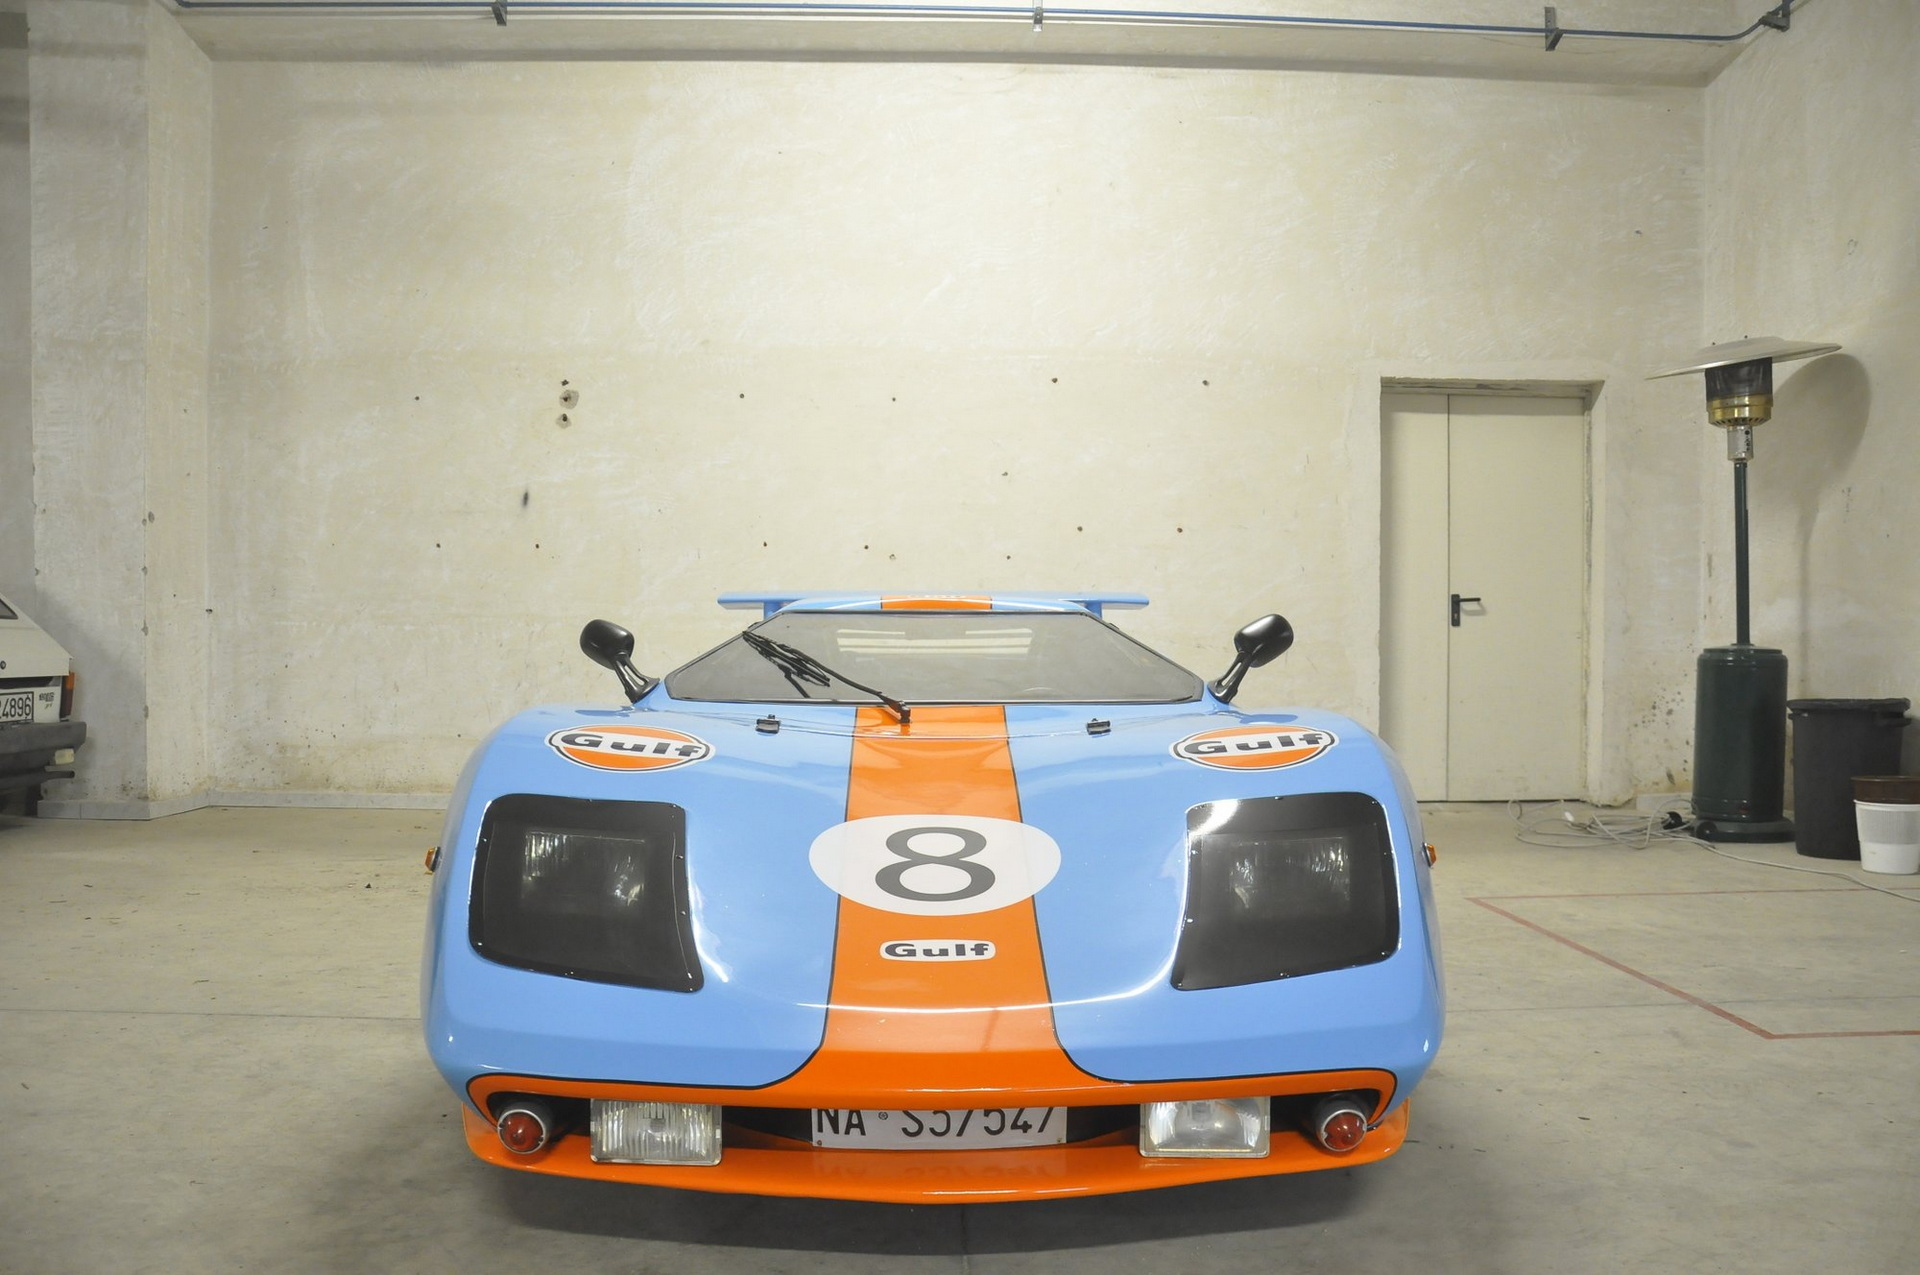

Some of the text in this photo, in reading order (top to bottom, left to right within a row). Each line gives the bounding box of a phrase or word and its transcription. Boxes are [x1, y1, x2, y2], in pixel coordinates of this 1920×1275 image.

[0, 697, 31, 718] 4896
[561, 733, 702, 757] Gulf
[1184, 733, 1323, 755] Gulf
[875, 826, 996, 902] 8
[885, 943, 990, 957] Gulf
[817, 1108, 866, 1136] NA
